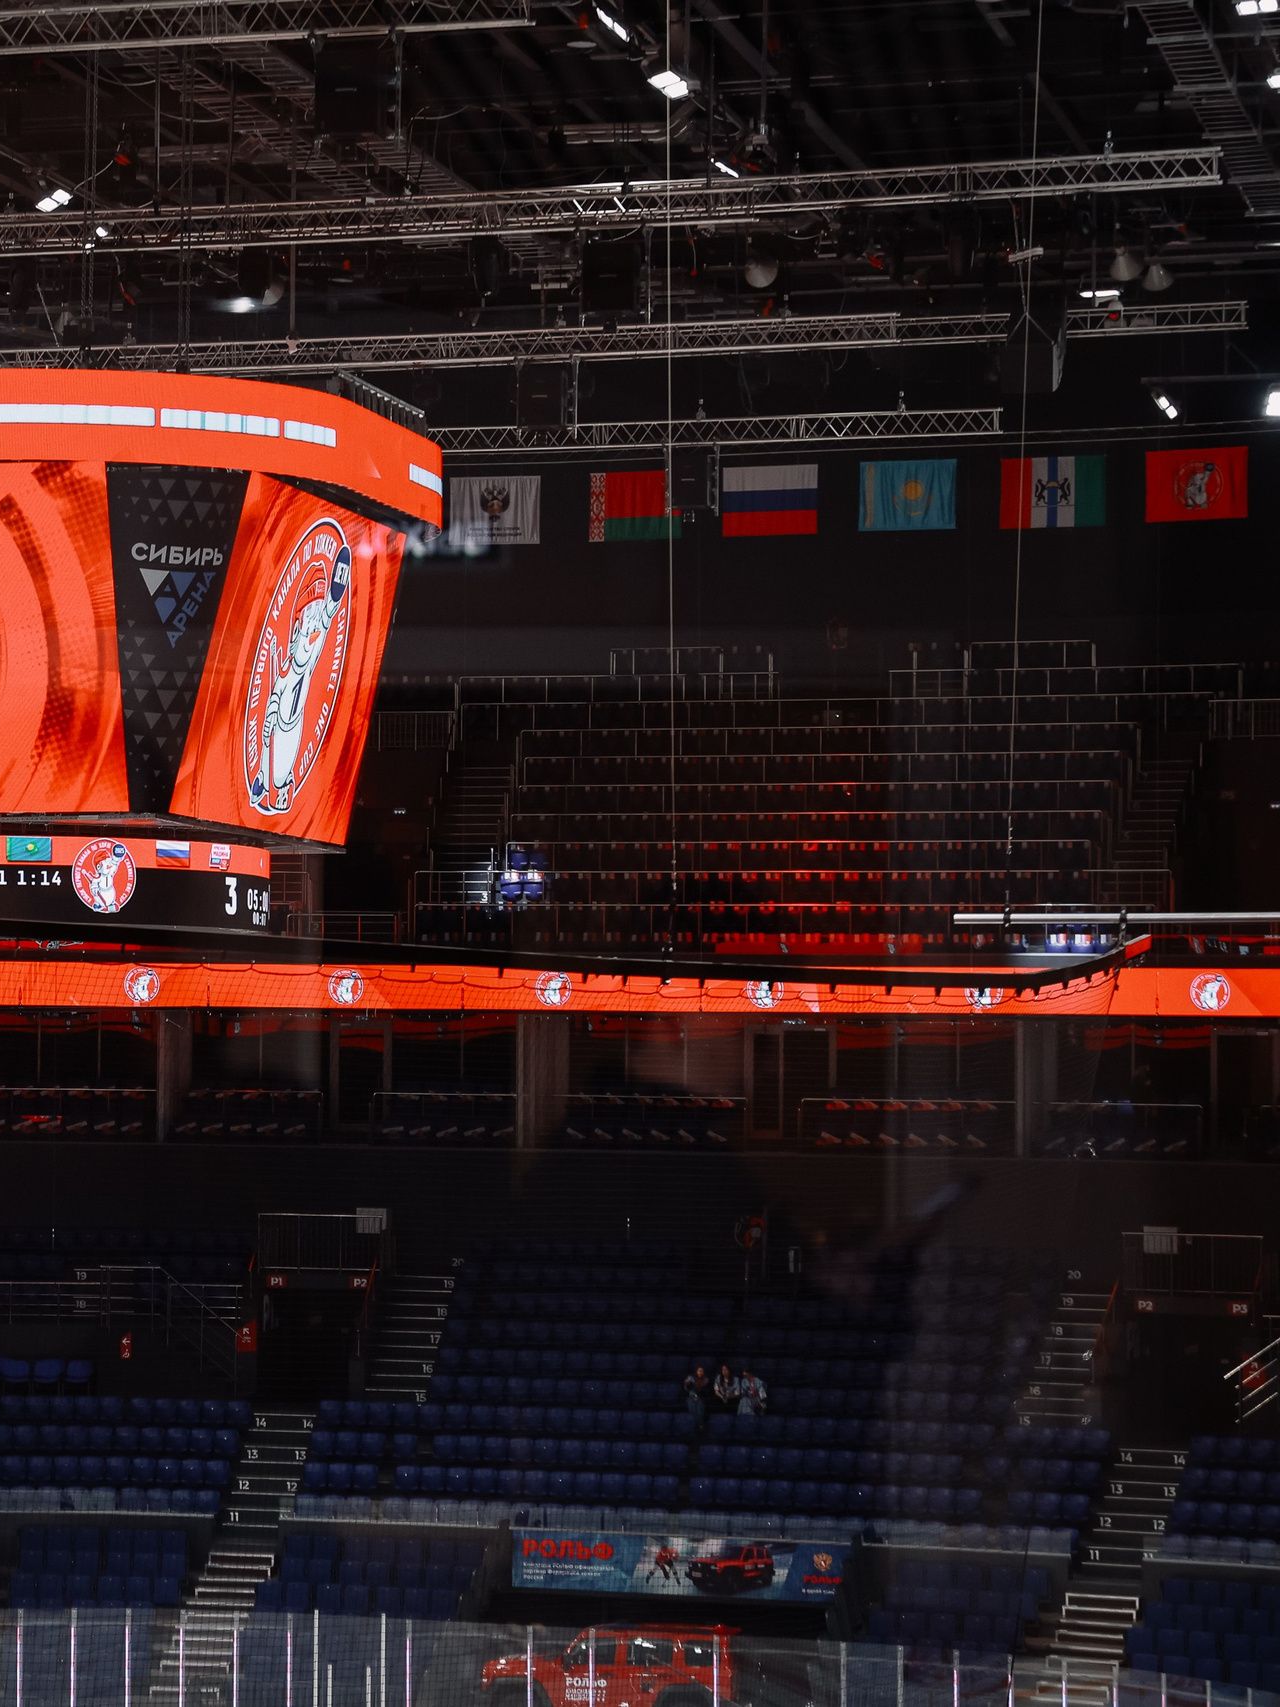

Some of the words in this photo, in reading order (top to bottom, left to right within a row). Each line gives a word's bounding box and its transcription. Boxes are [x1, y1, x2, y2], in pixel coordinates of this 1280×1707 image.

[131, 542, 224, 566] СИБИРЬ
[165, 571, 216, 649] АРЕНА
[250, 626, 274, 708] ПЕРВОГО
[271, 556, 301, 622] КАНАЛА
[327, 607, 346, 693] CHANNEL
[313, 702, 330, 741] ONE
[299, 741, 314, 777] CUP
[17, 870, 62, 886] 1:14
[225, 876, 237, 915] 3
[451, 1257, 465, 1267] 20
[76, 1271, 87, 1280] 19
[1067, 1270, 1081, 1279] 20
[271, 1277, 283, 1286] P1
[354, 1278, 367, 1287] P2
[443, 1279, 455, 1289] 19
[1062, 1297, 1074, 1306] 19
[1138, 1300, 1153, 1311] P2
[437, 1307, 448, 1317] 18
[1232, 1303, 1248, 1314] P3
[1051, 1326, 1063, 1335] 18
[430, 1334, 441, 1344] 17
[1041, 1355, 1051, 1365] 17
[422, 1364, 434, 1374] 16
[1029, 1386, 1041, 1395] 16
[415, 1392, 427, 1402] 15
[255, 1417, 267, 1427] 14
[302, 1419, 314, 1429] 14
[1019, 1416, 1031, 1426] 15
[247, 1449, 259, 1459] 13
[294, 1450, 306, 1460] 13
[1120, 1452, 1132, 1463] 14
[1173, 1454, 1186, 1465] 14
[238, 1480, 250, 1490] 12
[286, 1481, 298, 1492] 12
[1110, 1483, 1123, 1494] 13
[1163, 1486, 1176, 1497] 13
[230, 1511, 239, 1522] 11
[1099, 1516, 1112, 1527] 12
[1152, 1519, 1166, 1531] 12
[523, 1539, 614, 1560] РОЛЬФ
[1089, 1549, 1100, 1561] 11
